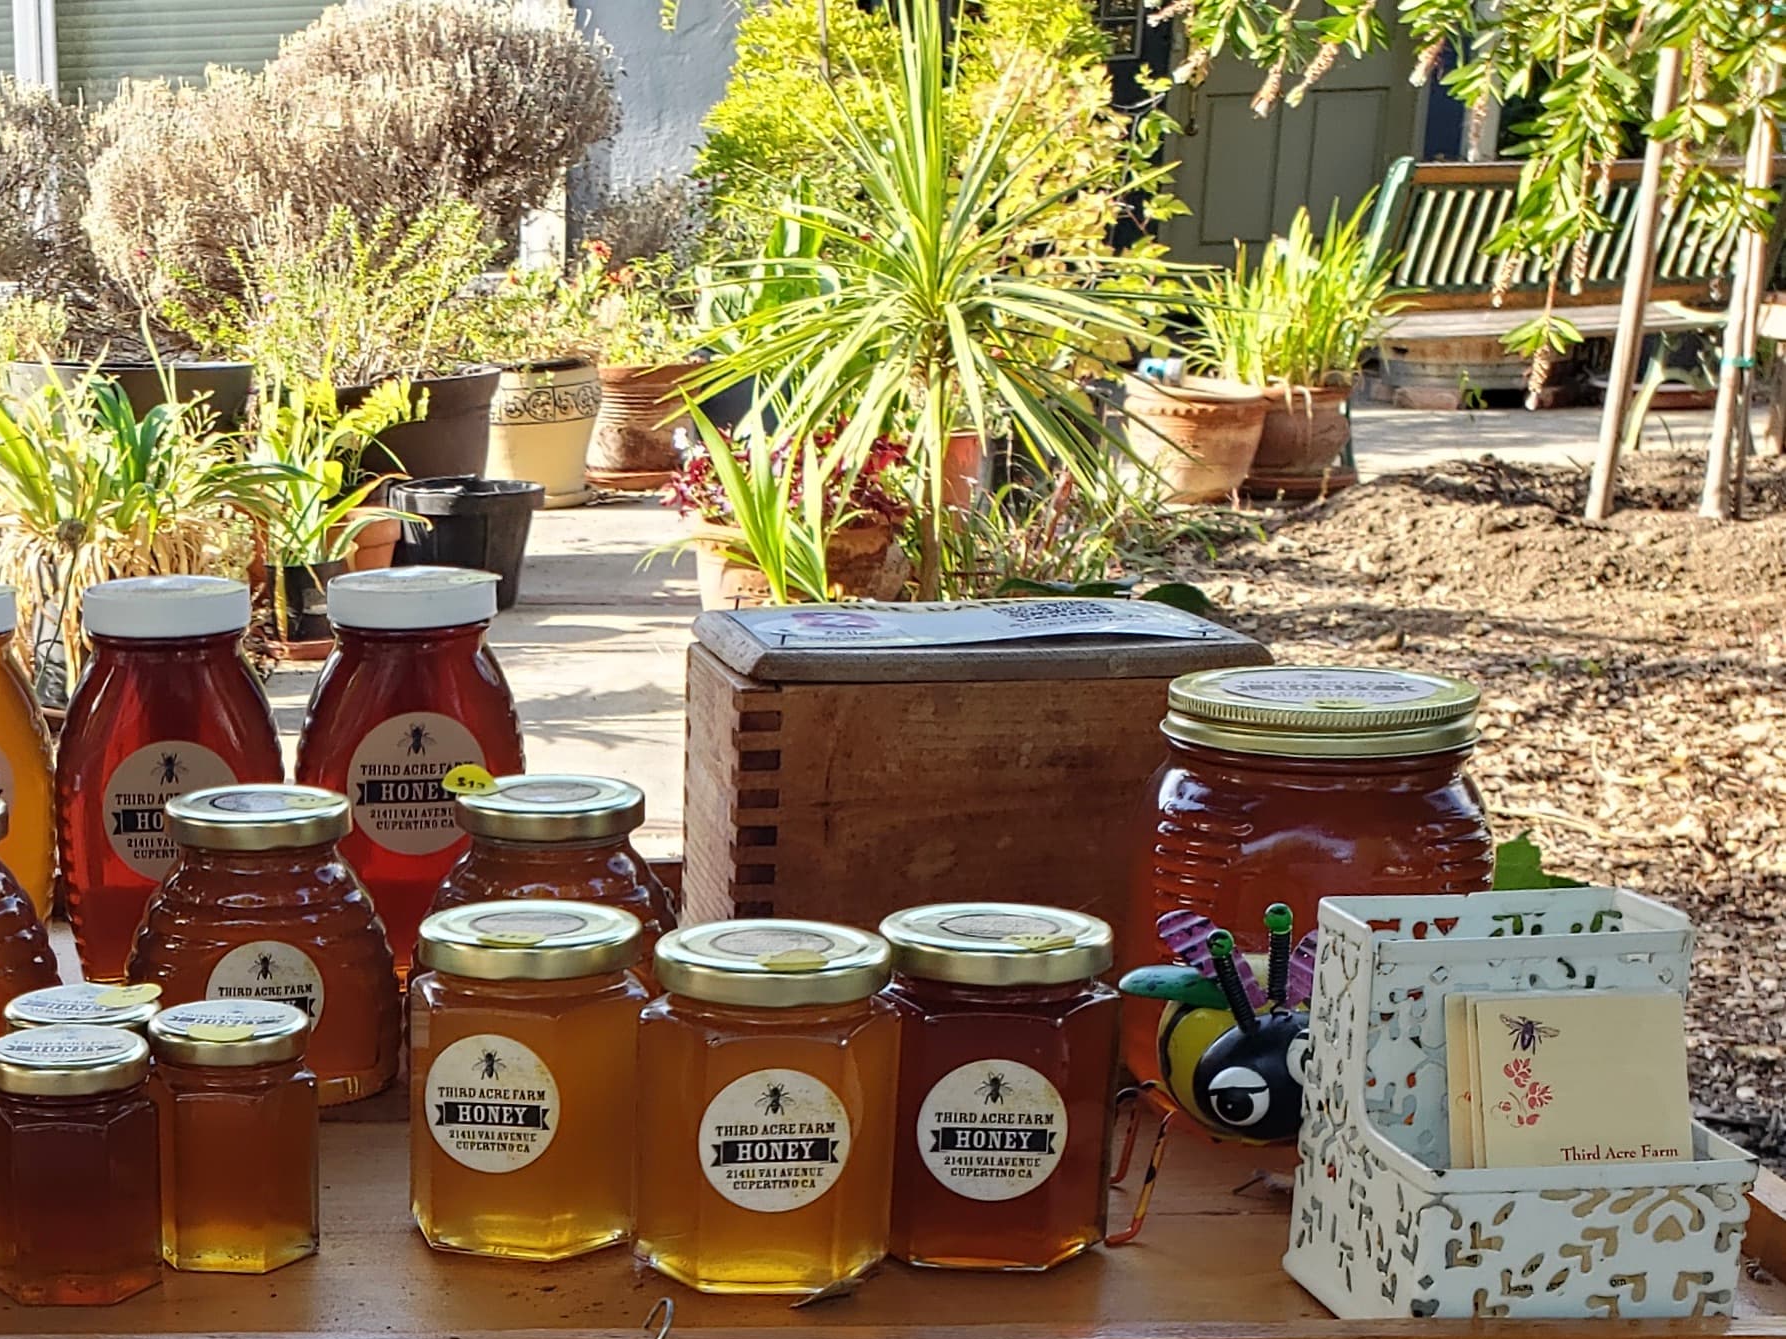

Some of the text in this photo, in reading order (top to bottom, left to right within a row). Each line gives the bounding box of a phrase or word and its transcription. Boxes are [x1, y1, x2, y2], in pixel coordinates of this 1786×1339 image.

[360, 764, 400, 776] THIRD
[403, 763, 437, 776] ACRE
[381, 782, 449, 800] HONE
[115, 793, 155, 806] THIRD
[370, 808, 454, 819] 21411 VAI AVENU
[376, 819, 455, 830] CUPERTINO CA
[134, 849, 180, 859] CUPERTI
[218, 983, 313, 997] THIRD ACRE FARM
[438, 1086, 546, 1101] THIRD ACRE FARM
[457, 1105, 527, 1124] HONEY
[935, 1112, 1054, 1125] THIRD ACRE FARM
[449, 1130, 537, 1142] 21411 VAI AVENUE
[716, 1122, 836, 1137] THIRD ACRE FARM
[955, 1130, 1033, 1149] HONEY
[456, 1141, 530, 1153] CUPERTINO CA
[737, 1141, 815, 1160] HONEY
[1560, 1144, 1678, 1161] Third Acre Farm
[944, 1156, 1041, 1167] 21411 VAI AVENUE
[726, 1167, 824, 1179] 21411 VAI AVENUE
[951, 1167, 1033, 1178] CUPERTINO CA
[733, 1179, 816, 1190] CUPERTINO CA
